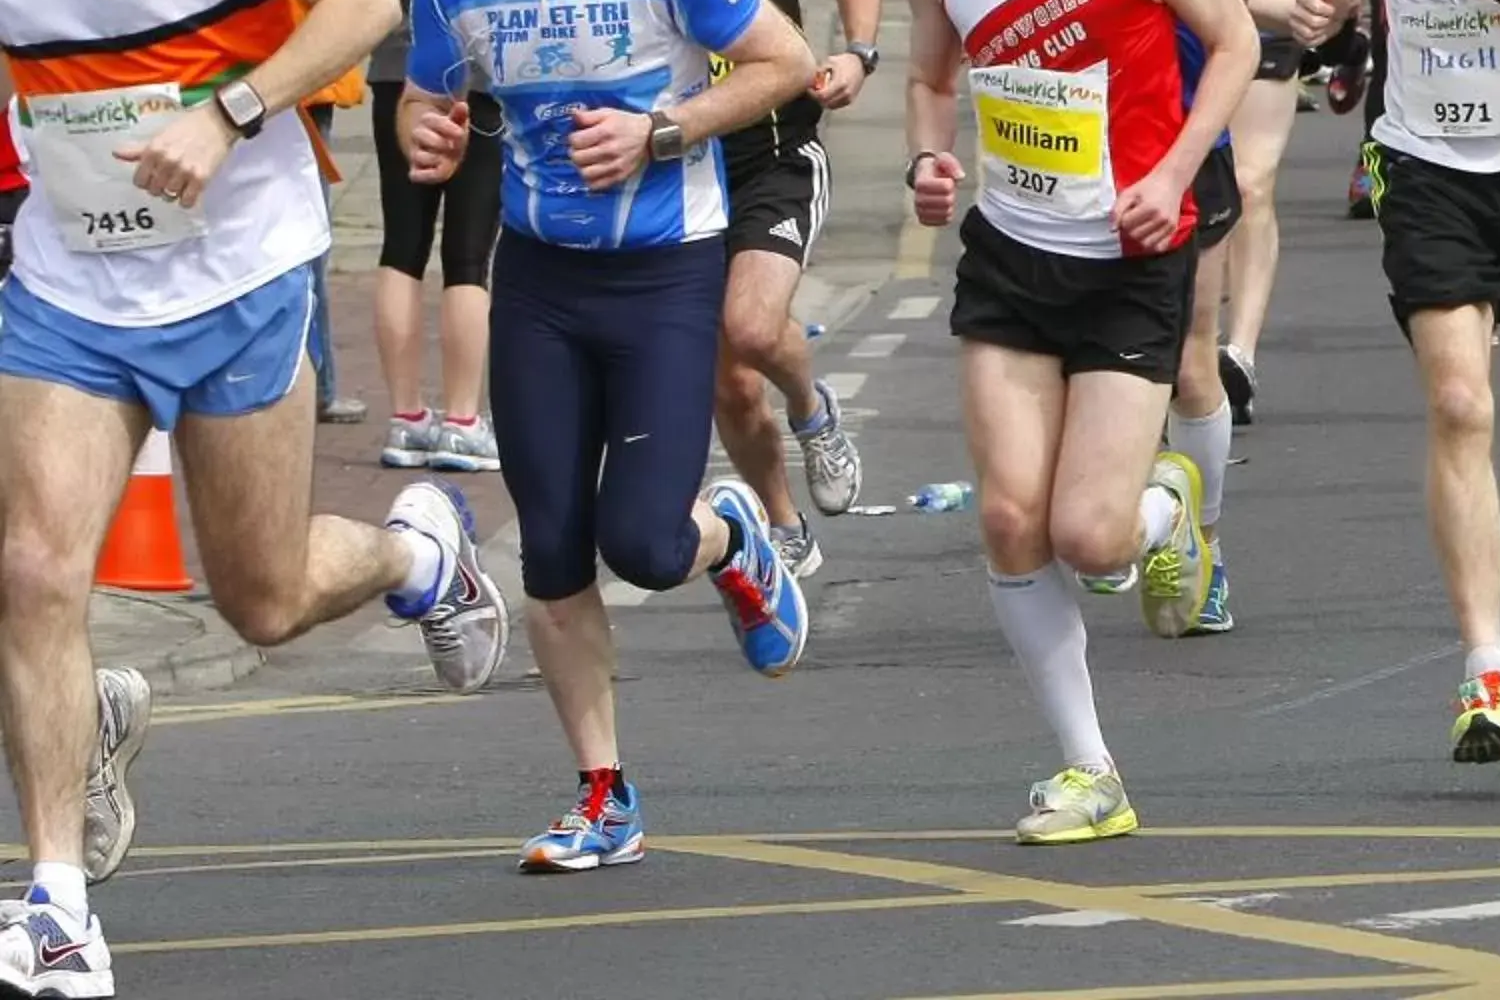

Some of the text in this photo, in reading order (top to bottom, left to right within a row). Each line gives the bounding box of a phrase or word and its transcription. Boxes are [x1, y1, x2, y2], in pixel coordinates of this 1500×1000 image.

[541, 26, 577, 39] BIKE
[592, 22, 630, 37] RUN
[1425, 9, 1488, 34] Limerick
[1043, 21, 1087, 57] CLUB
[1002, 71, 1068, 105] Limerick
[1068, 85, 1103, 104] run
[62, 97, 138, 125] Limerick
[1434, 103, 1493, 123] 9371
[991, 118, 1079, 153] William
[1007, 165, 1058, 196] 3207
[82, 207, 155, 234] 7416
